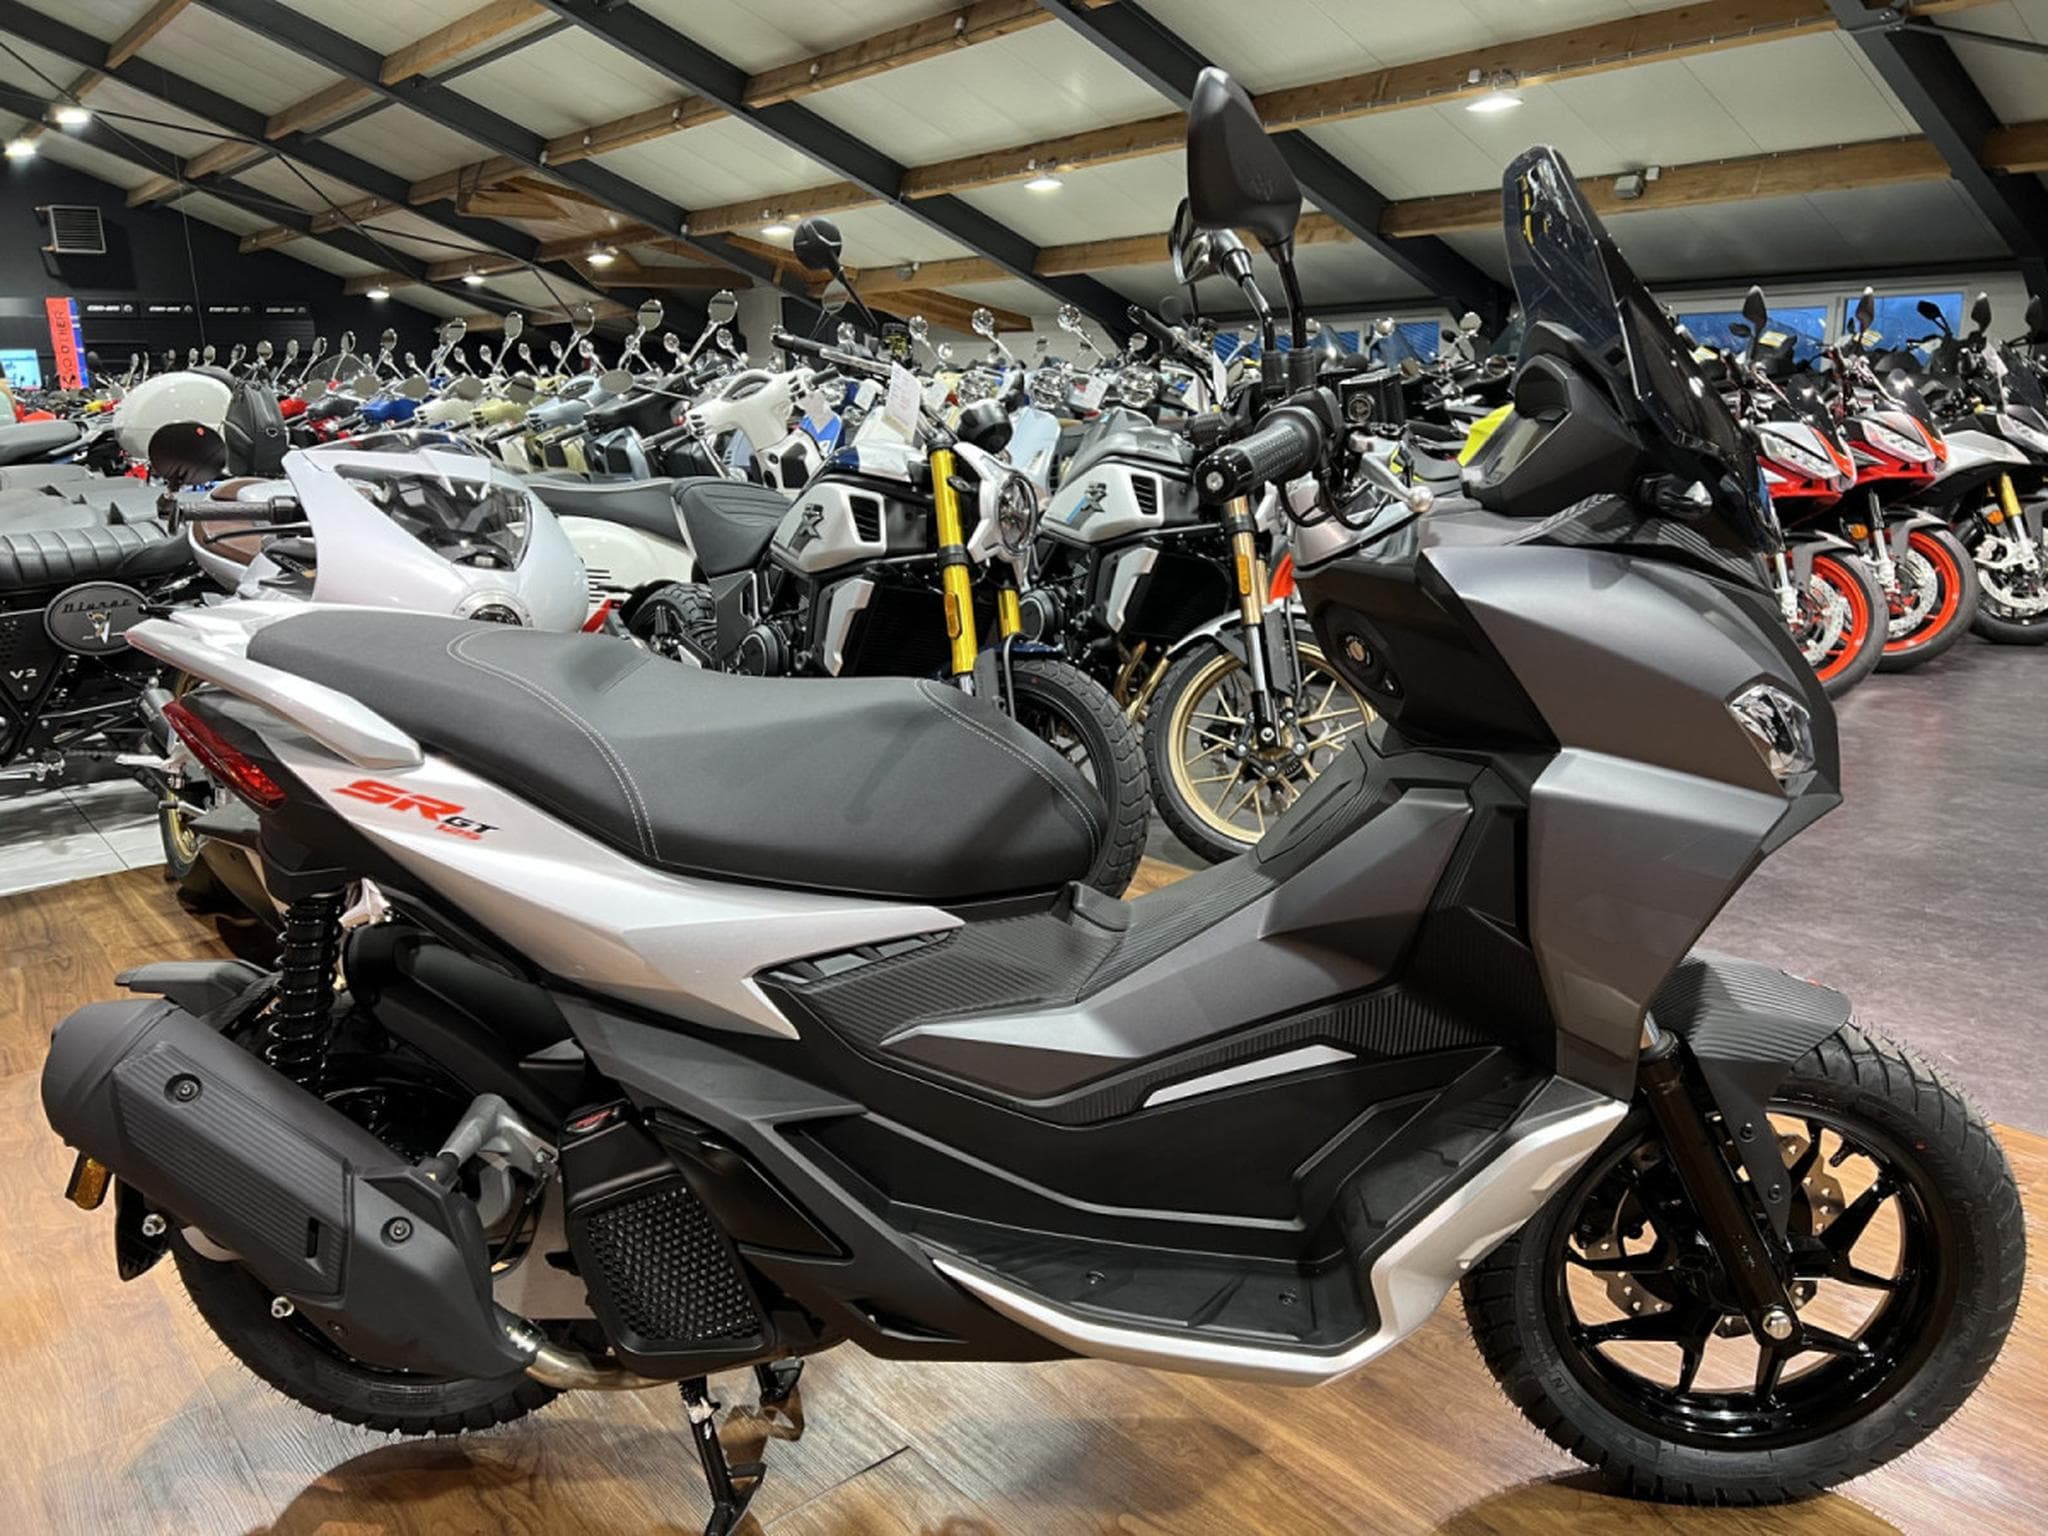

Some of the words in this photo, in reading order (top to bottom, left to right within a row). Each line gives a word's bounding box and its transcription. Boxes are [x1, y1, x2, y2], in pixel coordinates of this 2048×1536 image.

[9, 668, 38, 680] V2
[333, 779, 465, 821] SR
[442, 816, 500, 834] GT
